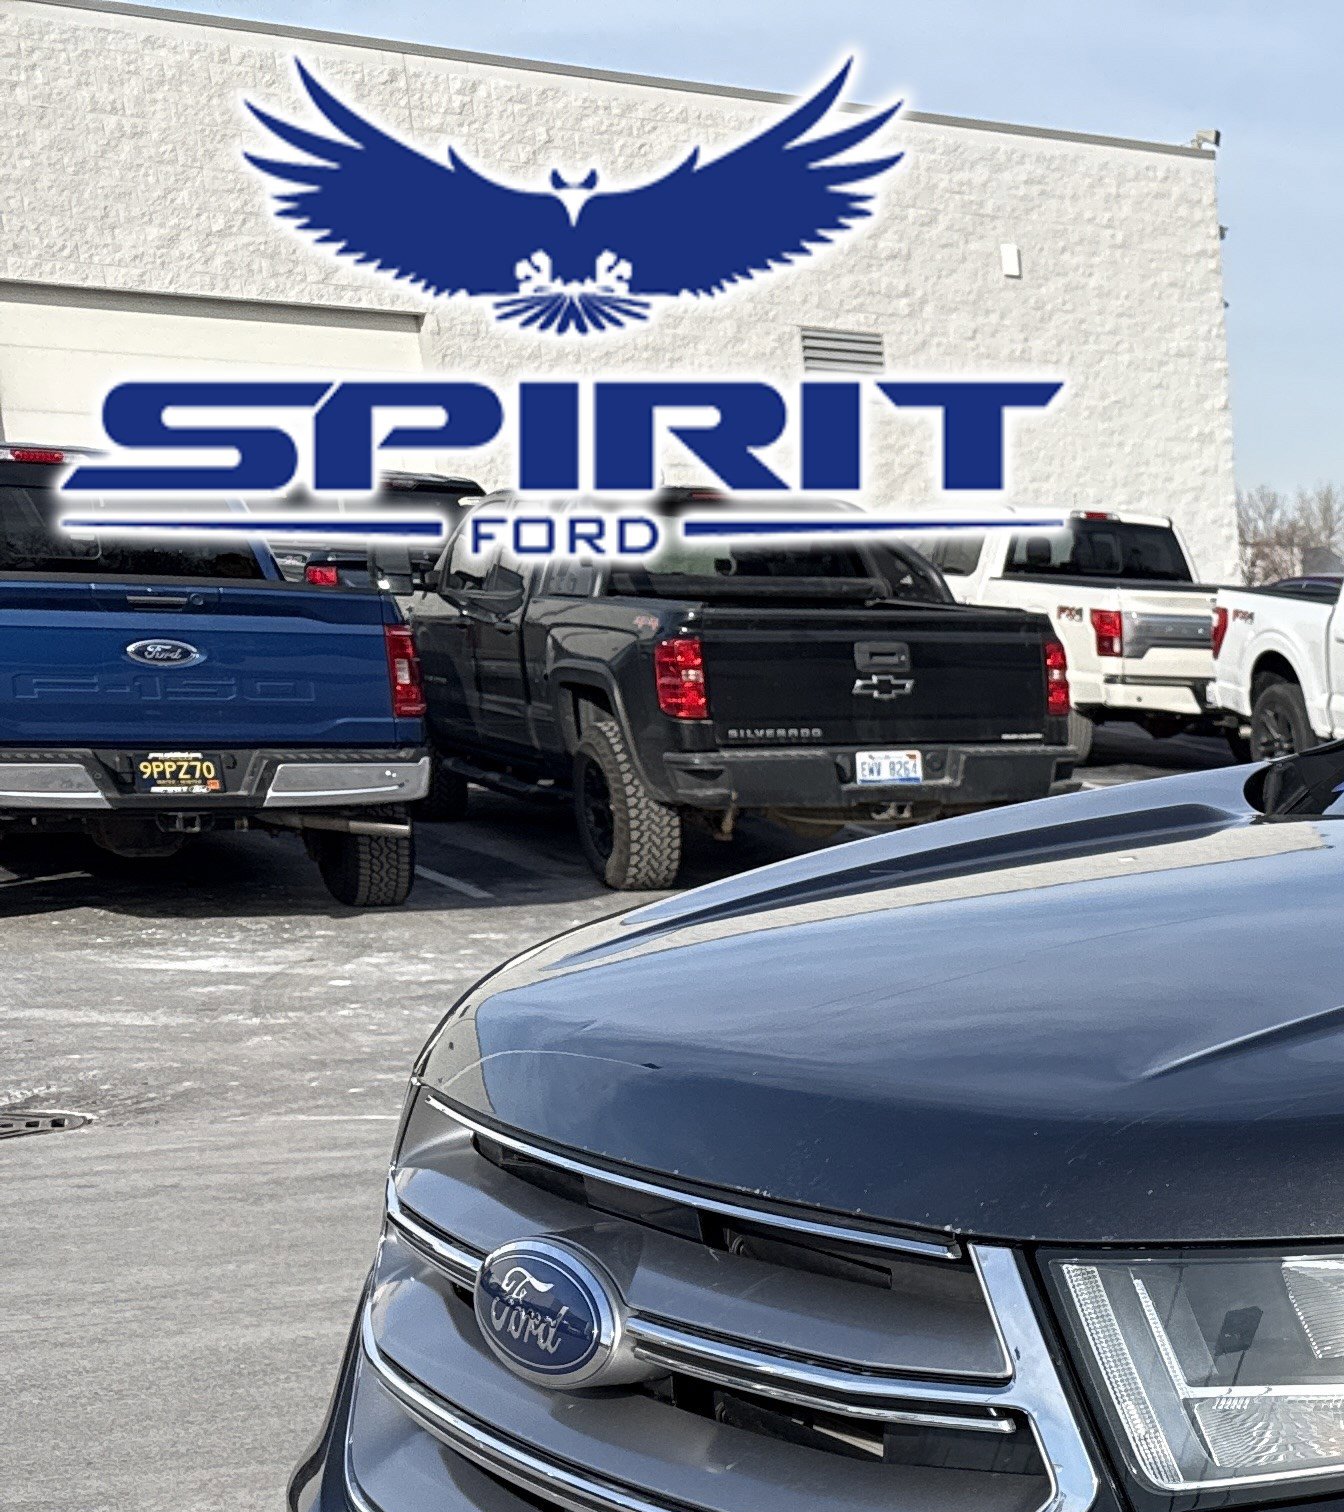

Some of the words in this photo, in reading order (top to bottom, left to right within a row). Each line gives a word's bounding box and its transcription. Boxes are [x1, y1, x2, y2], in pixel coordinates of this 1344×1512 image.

[144, 644, 182, 659] Ford
[12, 673, 315, 701] F-150
[728, 728, 823, 739] SILVERADO
[139, 761, 215, 779] 9PPZ70
[491, 1266, 570, 1355] Ford
